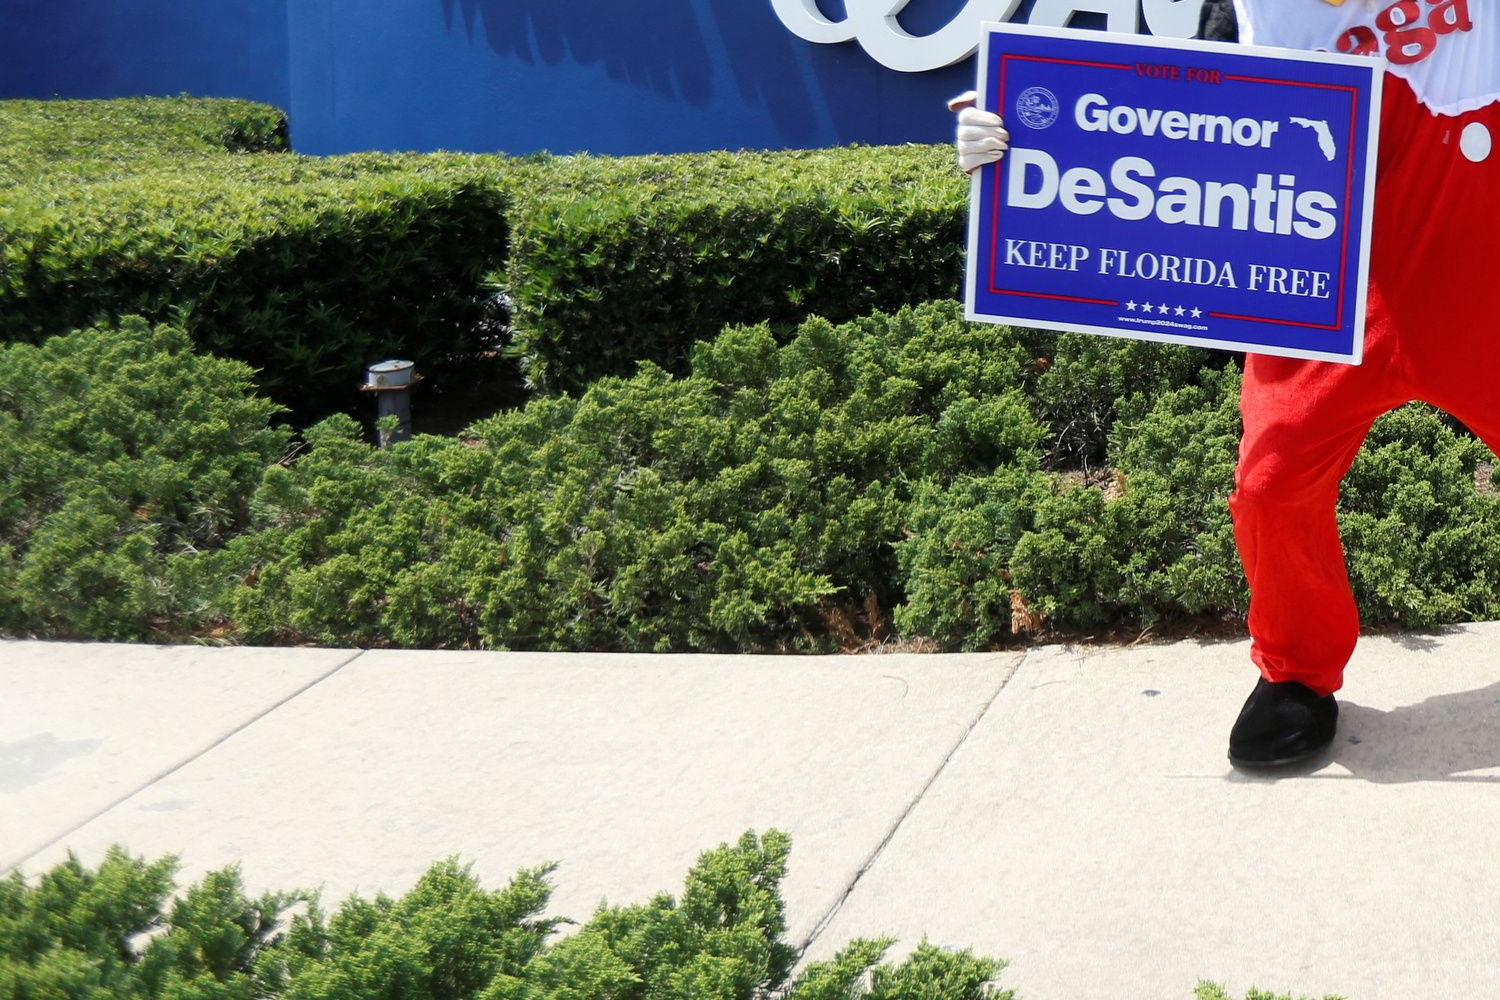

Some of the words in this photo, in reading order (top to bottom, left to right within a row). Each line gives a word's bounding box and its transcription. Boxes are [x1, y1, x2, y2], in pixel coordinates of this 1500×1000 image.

[1135, 63, 1180, 80] VOTE
[1186, 68, 1221, 84] FOR
[1075, 93, 1279, 148] Governor
[1007, 147, 1338, 240] DeSantis
[1004, 238, 1090, 276] KEEP
[1098, 248, 1238, 289] FLORIDA
[1248, 264, 1331, 299] FREE
[1118, 316, 1209, 331] www.trump2024swag.com
